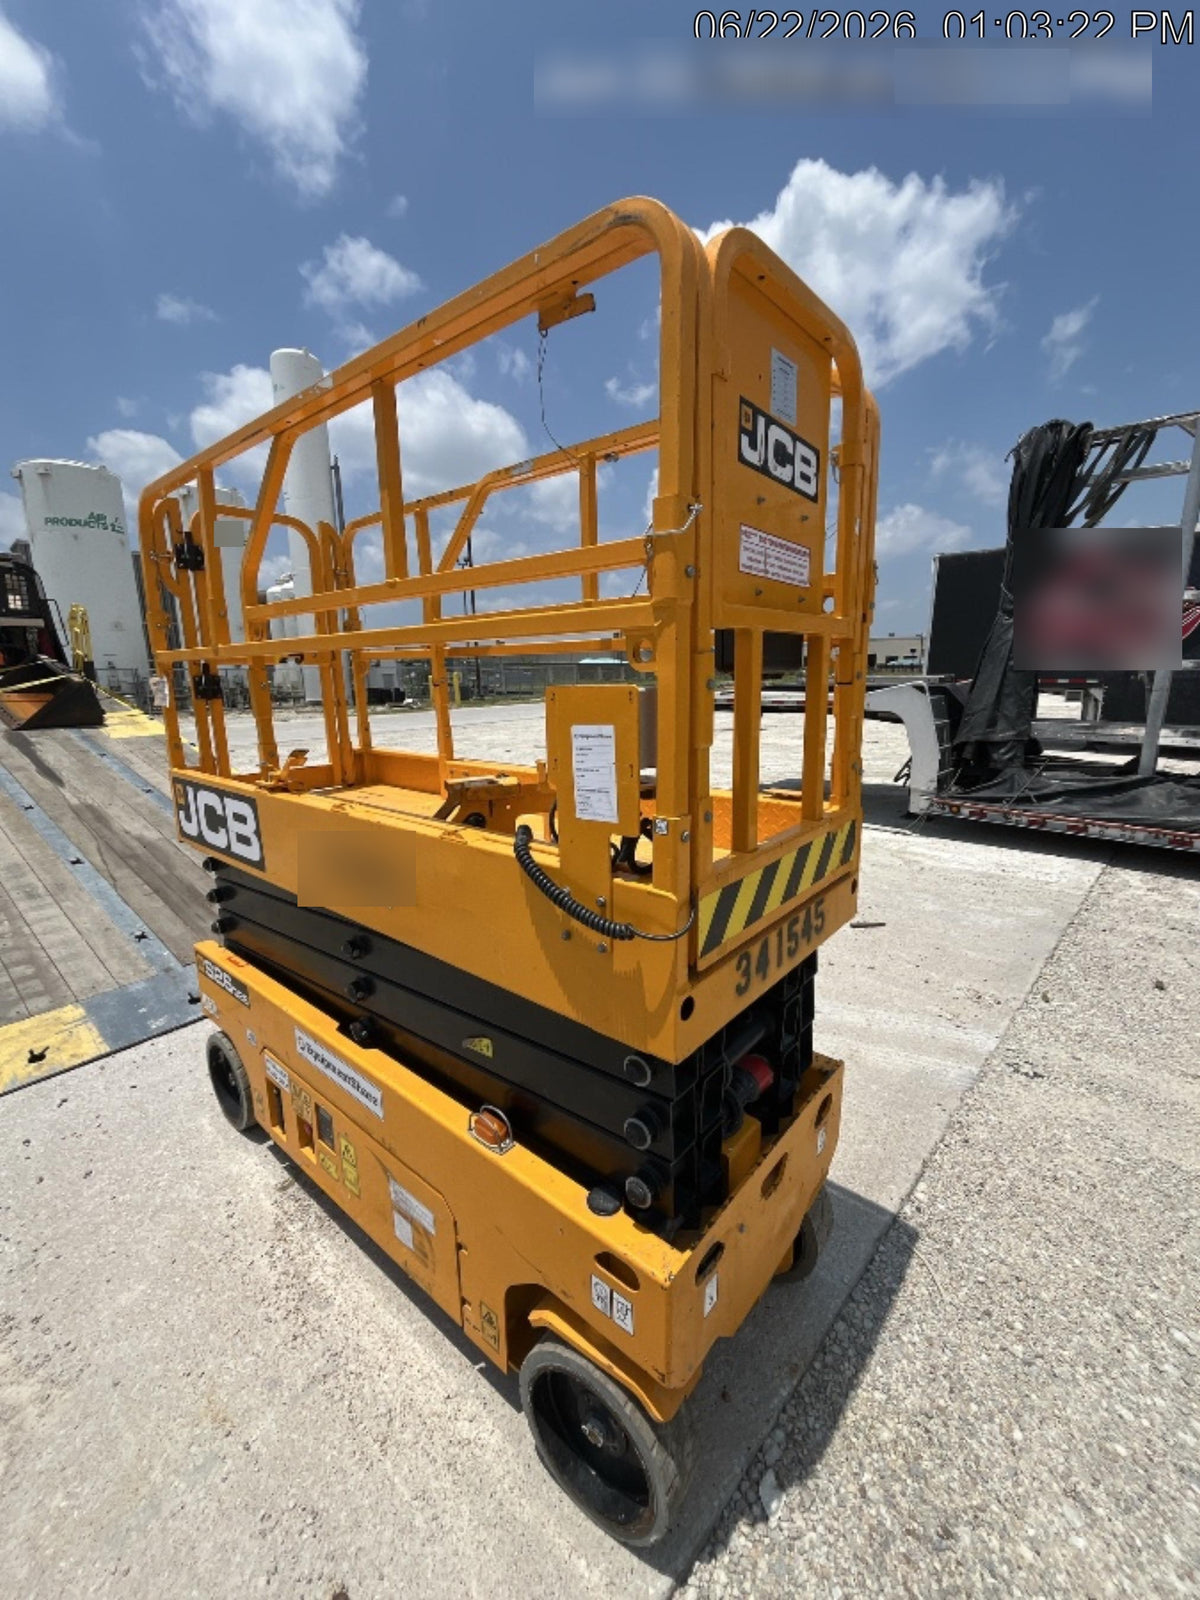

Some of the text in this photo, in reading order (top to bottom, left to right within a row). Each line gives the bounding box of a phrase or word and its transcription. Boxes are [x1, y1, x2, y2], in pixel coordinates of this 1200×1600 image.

[741, 414, 817, 497] JCB
[44, 516, 109, 531] PRODUCTS
[88, 511, 107, 521] AIR
[179, 785, 260, 861] JCB
[735, 895, 825, 996] 341545
